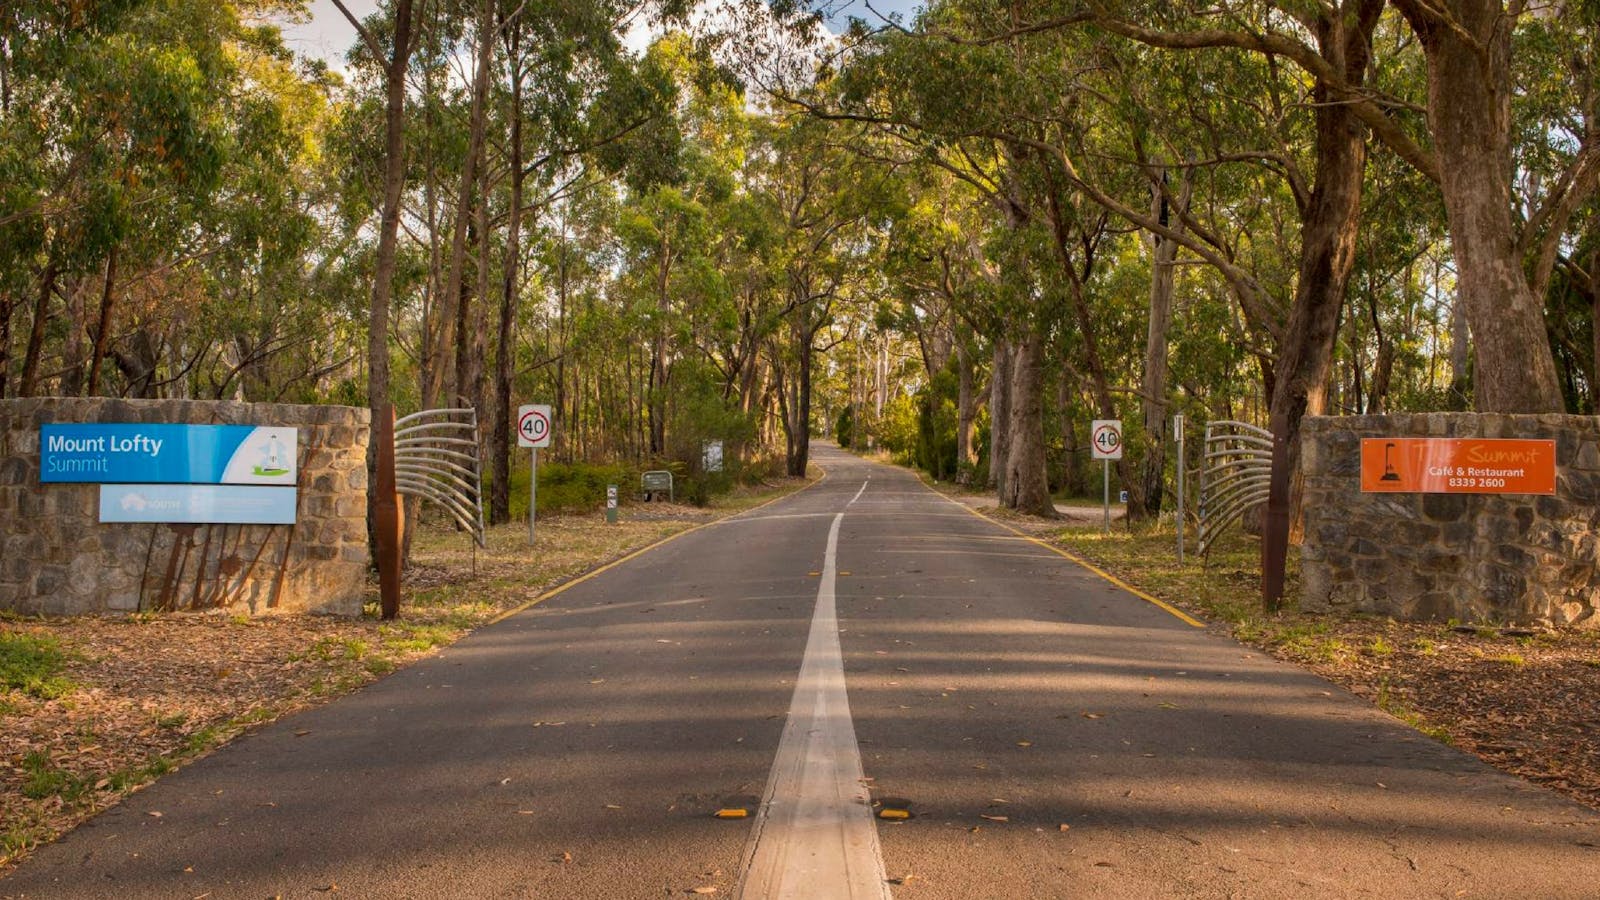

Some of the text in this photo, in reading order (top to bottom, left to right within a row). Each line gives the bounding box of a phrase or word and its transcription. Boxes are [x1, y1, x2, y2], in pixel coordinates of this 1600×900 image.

[523, 419, 544, 434] 40
[48, 434, 163, 457] Mount Lofty
[1097, 432, 1117, 447] 40
[1467, 445, 1541, 464] Summit
[48, 455, 108, 473] Summit
[1428, 466, 1525, 477] Café & Restaurant
[1449, 478, 1505, 488] 8339 2600
